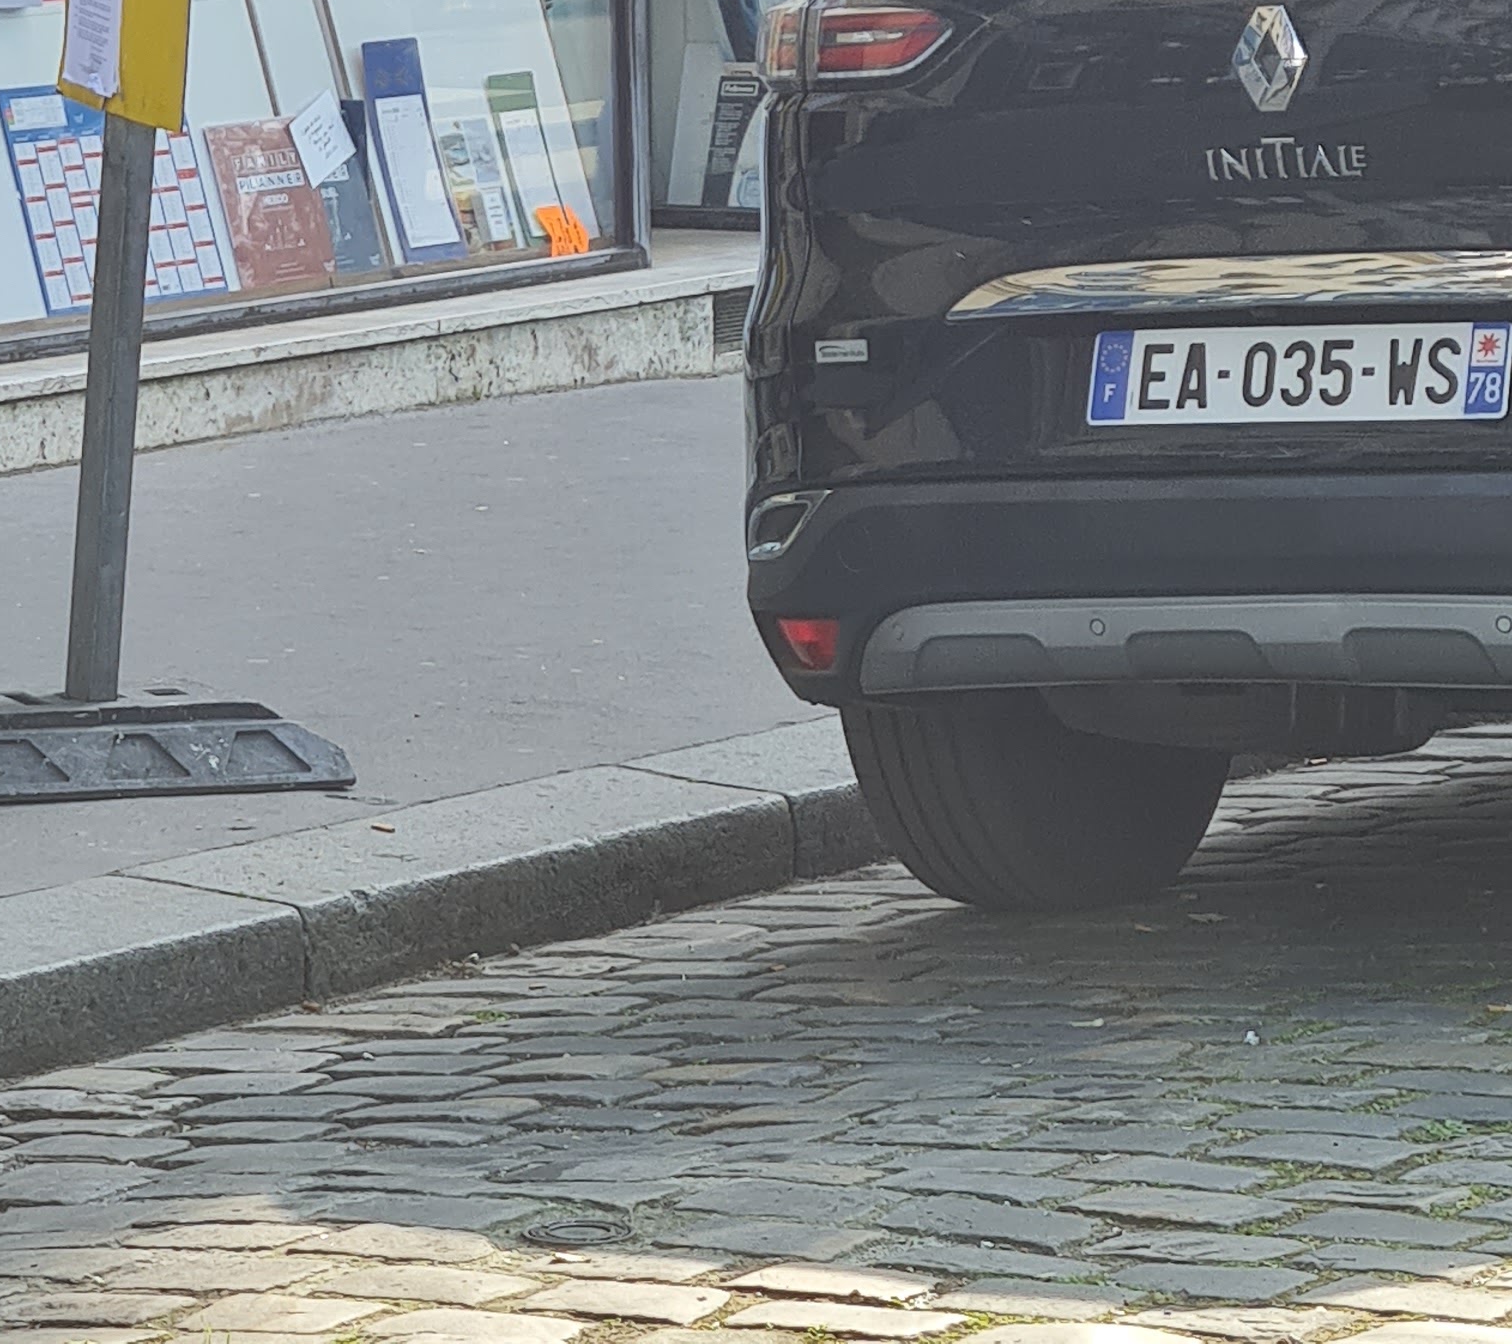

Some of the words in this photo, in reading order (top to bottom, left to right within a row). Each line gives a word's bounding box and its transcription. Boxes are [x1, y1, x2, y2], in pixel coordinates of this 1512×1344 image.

[234, 149, 299, 171] FAMILY
[1204, 136, 1368, 182] INITIALE
[238, 170, 303, 191] PLANNER
[1137, 337, 1462, 411] EA-035-WS
[1467, 371, 1502, 405] 78
[1103, 382, 1116, 403] F
